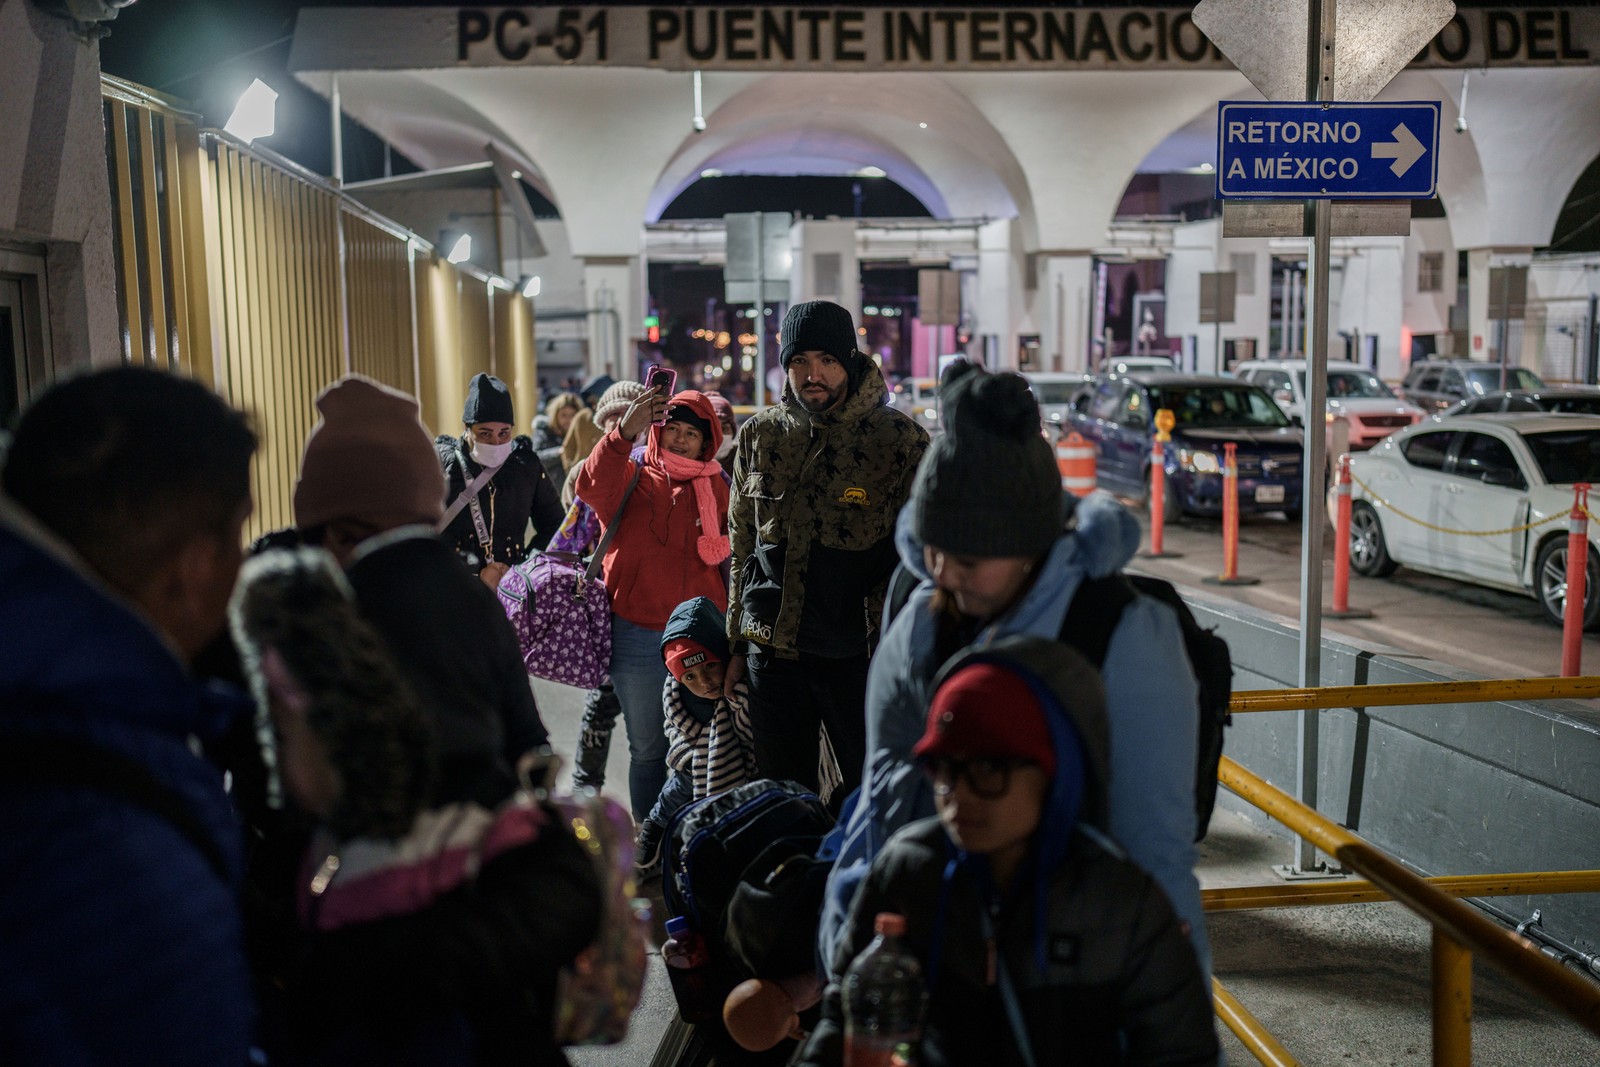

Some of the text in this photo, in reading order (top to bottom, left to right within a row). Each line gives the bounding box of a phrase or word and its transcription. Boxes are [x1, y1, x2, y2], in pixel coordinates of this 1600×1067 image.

[457, 9, 607, 62] PC-51
[648, 9, 866, 61] PUENTE
[884, 9, 1223, 62] INTERNACIO
[1488, 10, 1590, 60] DEL
[1228, 121, 1361, 144] RETORNO
[1227, 152, 1359, 180] A MÉXICO
[683, 652, 705, 668] MICKEY
